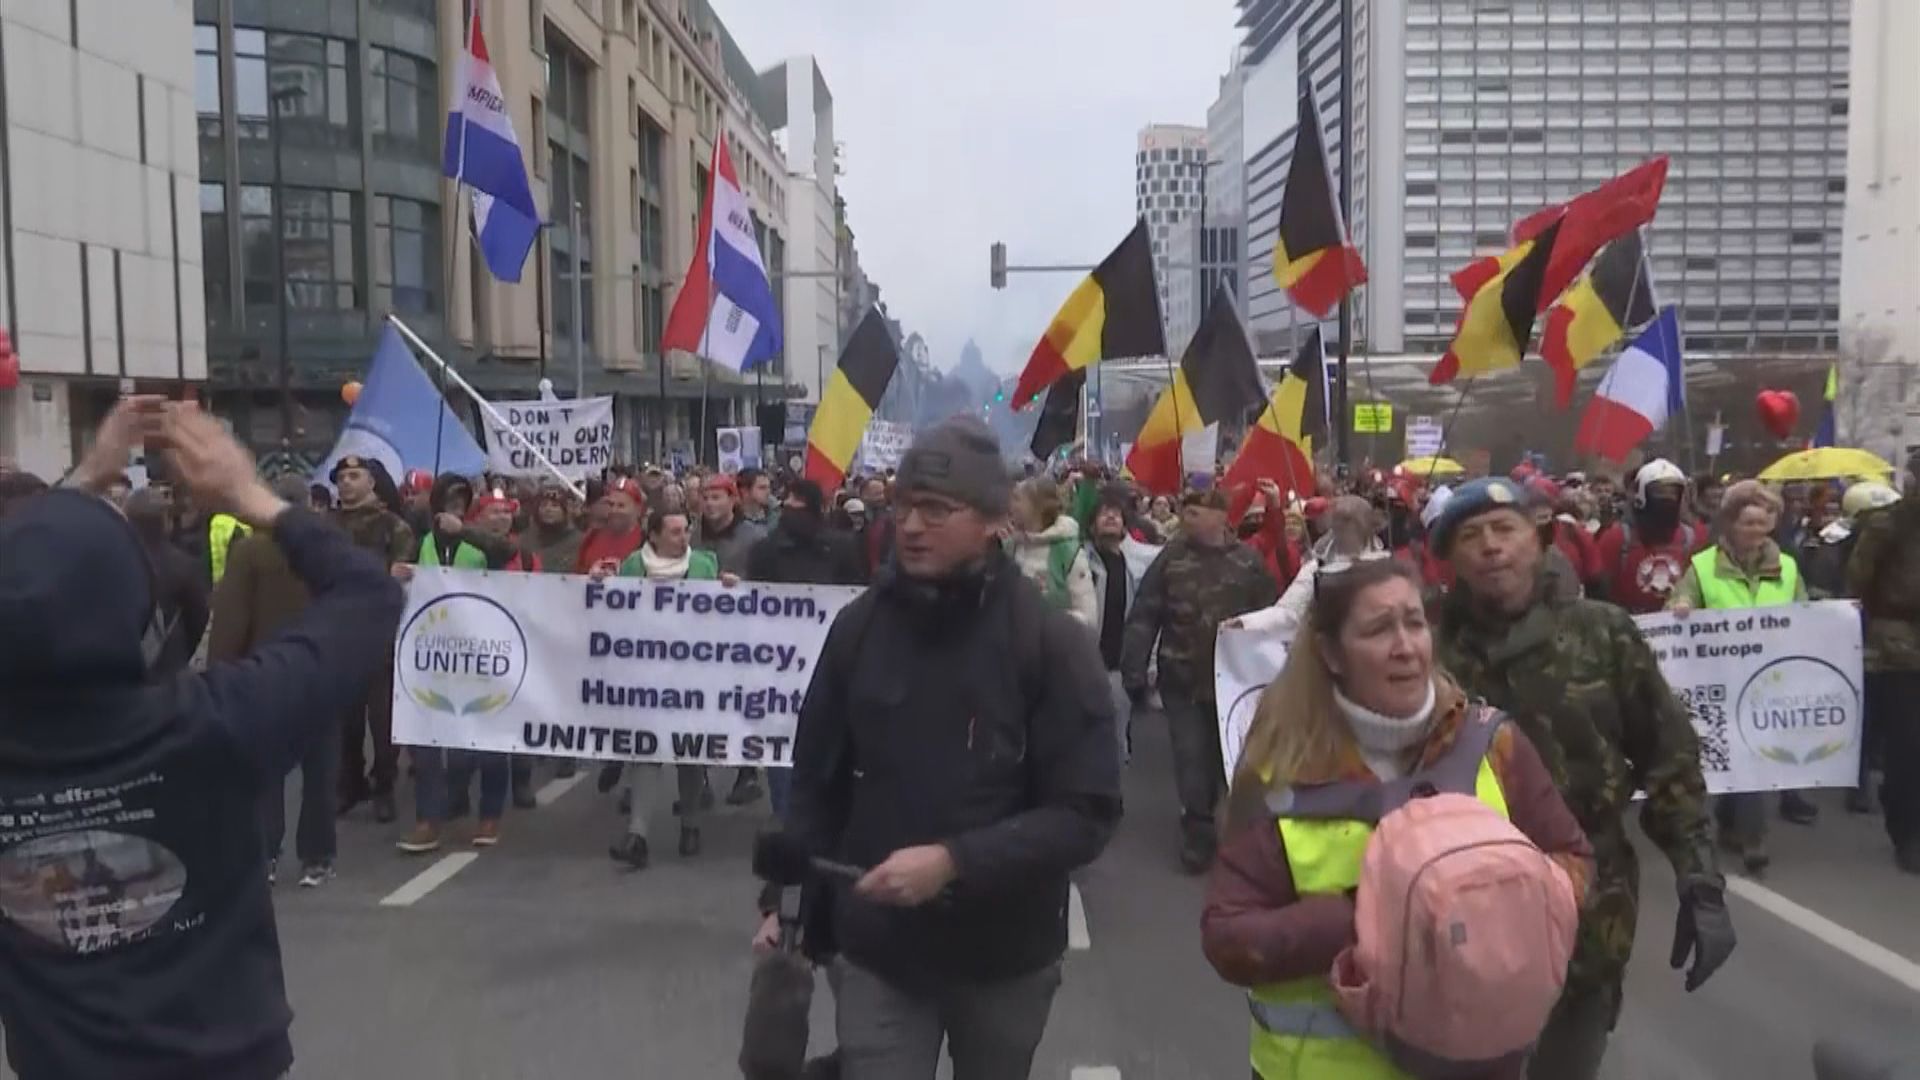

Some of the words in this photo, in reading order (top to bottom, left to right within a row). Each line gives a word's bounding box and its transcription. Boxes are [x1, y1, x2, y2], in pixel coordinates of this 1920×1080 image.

[574, 424, 609, 443] OUR
[586, 584, 641, 610] For
[654, 586, 827, 624] Freedom,
[1640, 623, 1683, 638] come
[1690, 620, 1730, 637] part
[1736, 618, 1755, 632] of
[1760, 615, 1790, 631] the
[415, 634, 512, 654] EUROPEANS
[589, 632, 806, 671] Democracy,
[1672, 645, 1688, 659] in
[1696, 642, 1763, 659] Europe
[415, 651, 510, 677] UNITED
[582, 679, 704, 710] Human
[719, 685, 801, 720] right
[1752, 706, 1846, 730] UNITED
[523, 722, 658, 756] UNITED
[671, 732, 728, 759] WE
[742, 735, 793, 762] ST
